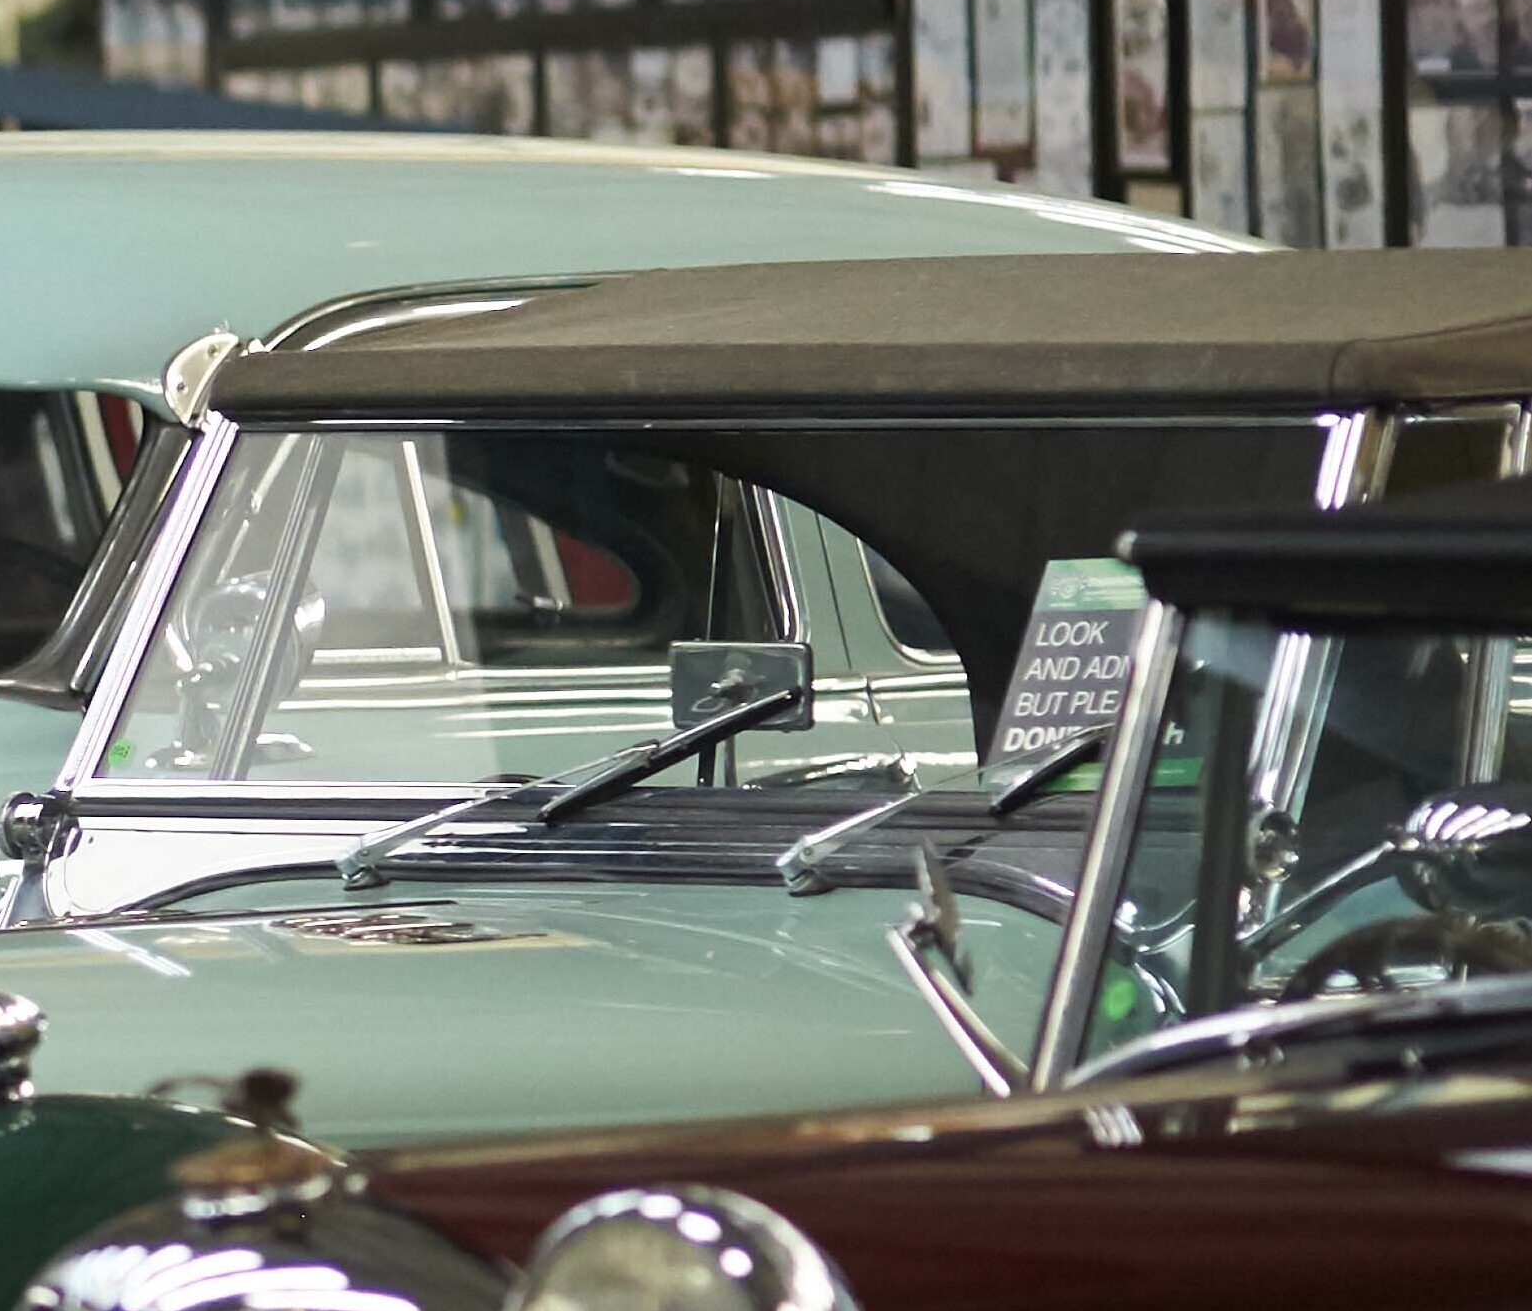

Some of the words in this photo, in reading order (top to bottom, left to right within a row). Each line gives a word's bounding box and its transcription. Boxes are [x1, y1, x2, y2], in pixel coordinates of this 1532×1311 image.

[1035, 621, 1109, 646] LOOK
[1024, 657, 1081, 681] AND
[1015, 691, 1068, 717] BUT
